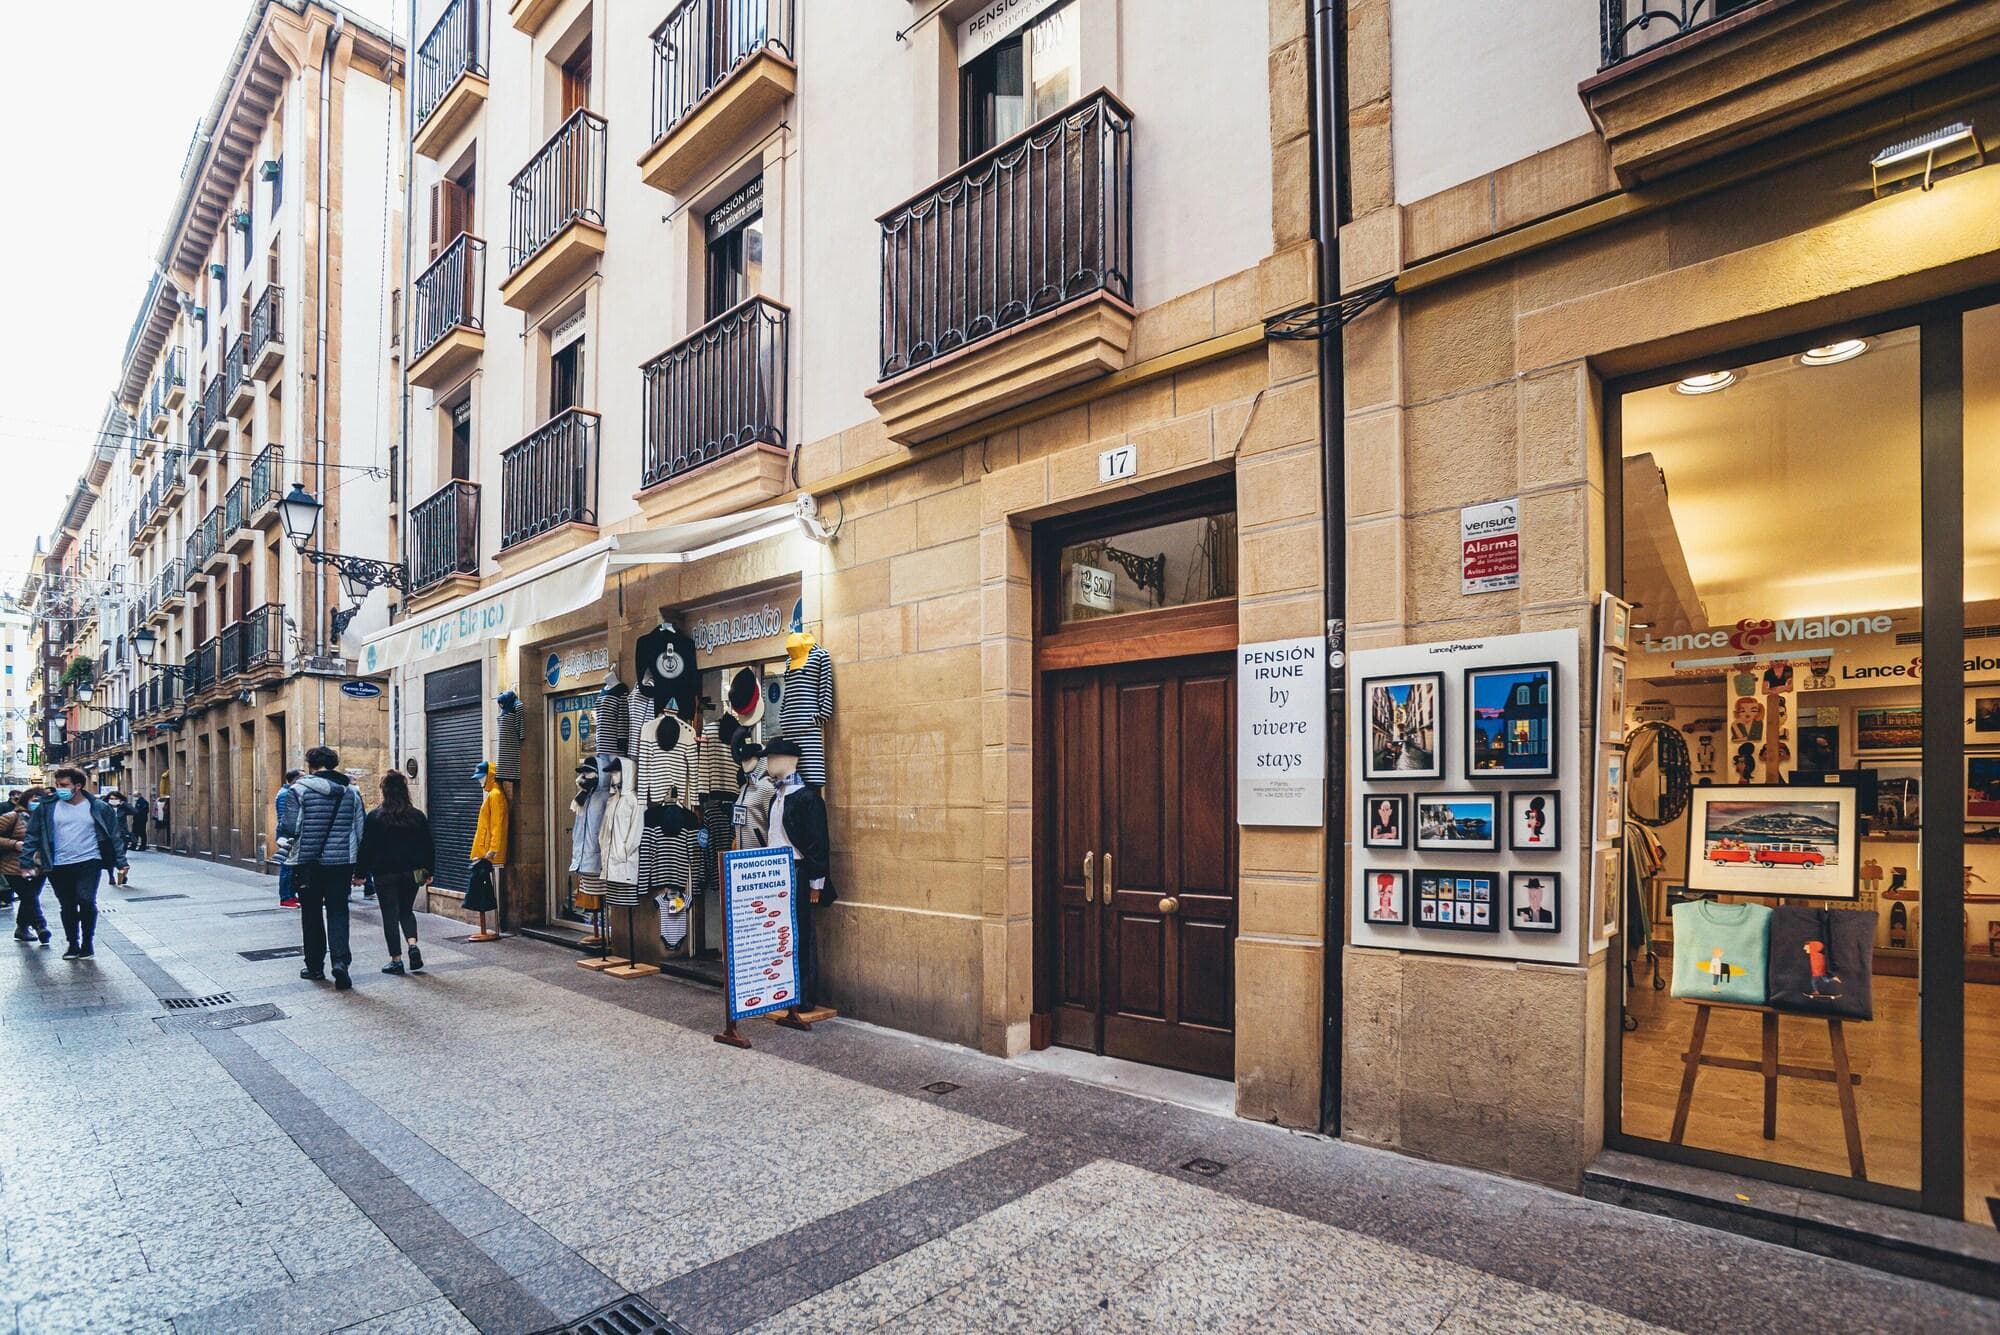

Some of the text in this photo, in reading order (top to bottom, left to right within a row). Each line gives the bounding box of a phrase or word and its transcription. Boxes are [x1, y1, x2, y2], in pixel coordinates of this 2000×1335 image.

[710, 192, 745, 225] PENSIÓN
[1106, 450, 1128, 476] 17
[1465, 516, 1517, 531] verisure
[1465, 540, 1518, 554] Alarma
[1466, 567, 1486, 575] Aviso
[691, 603, 782, 655] HOGAR BLANCO
[1645, 615, 1892, 654] Lance & Malone
[1244, 645, 1315, 665] PENSIÓN
[1255, 664, 1303, 680] IRUNE
[1842, 663, 1906, 680] Lance
[1269, 686, 1289, 708] by
[1252, 719, 1307, 736] vivere
[1256, 752, 1302, 772] stays
[733, 857, 787, 870] PROMOCIONES
[741, 869, 781, 881] HASTA FIN
[736, 879, 786, 893] EXISTENCIAS
